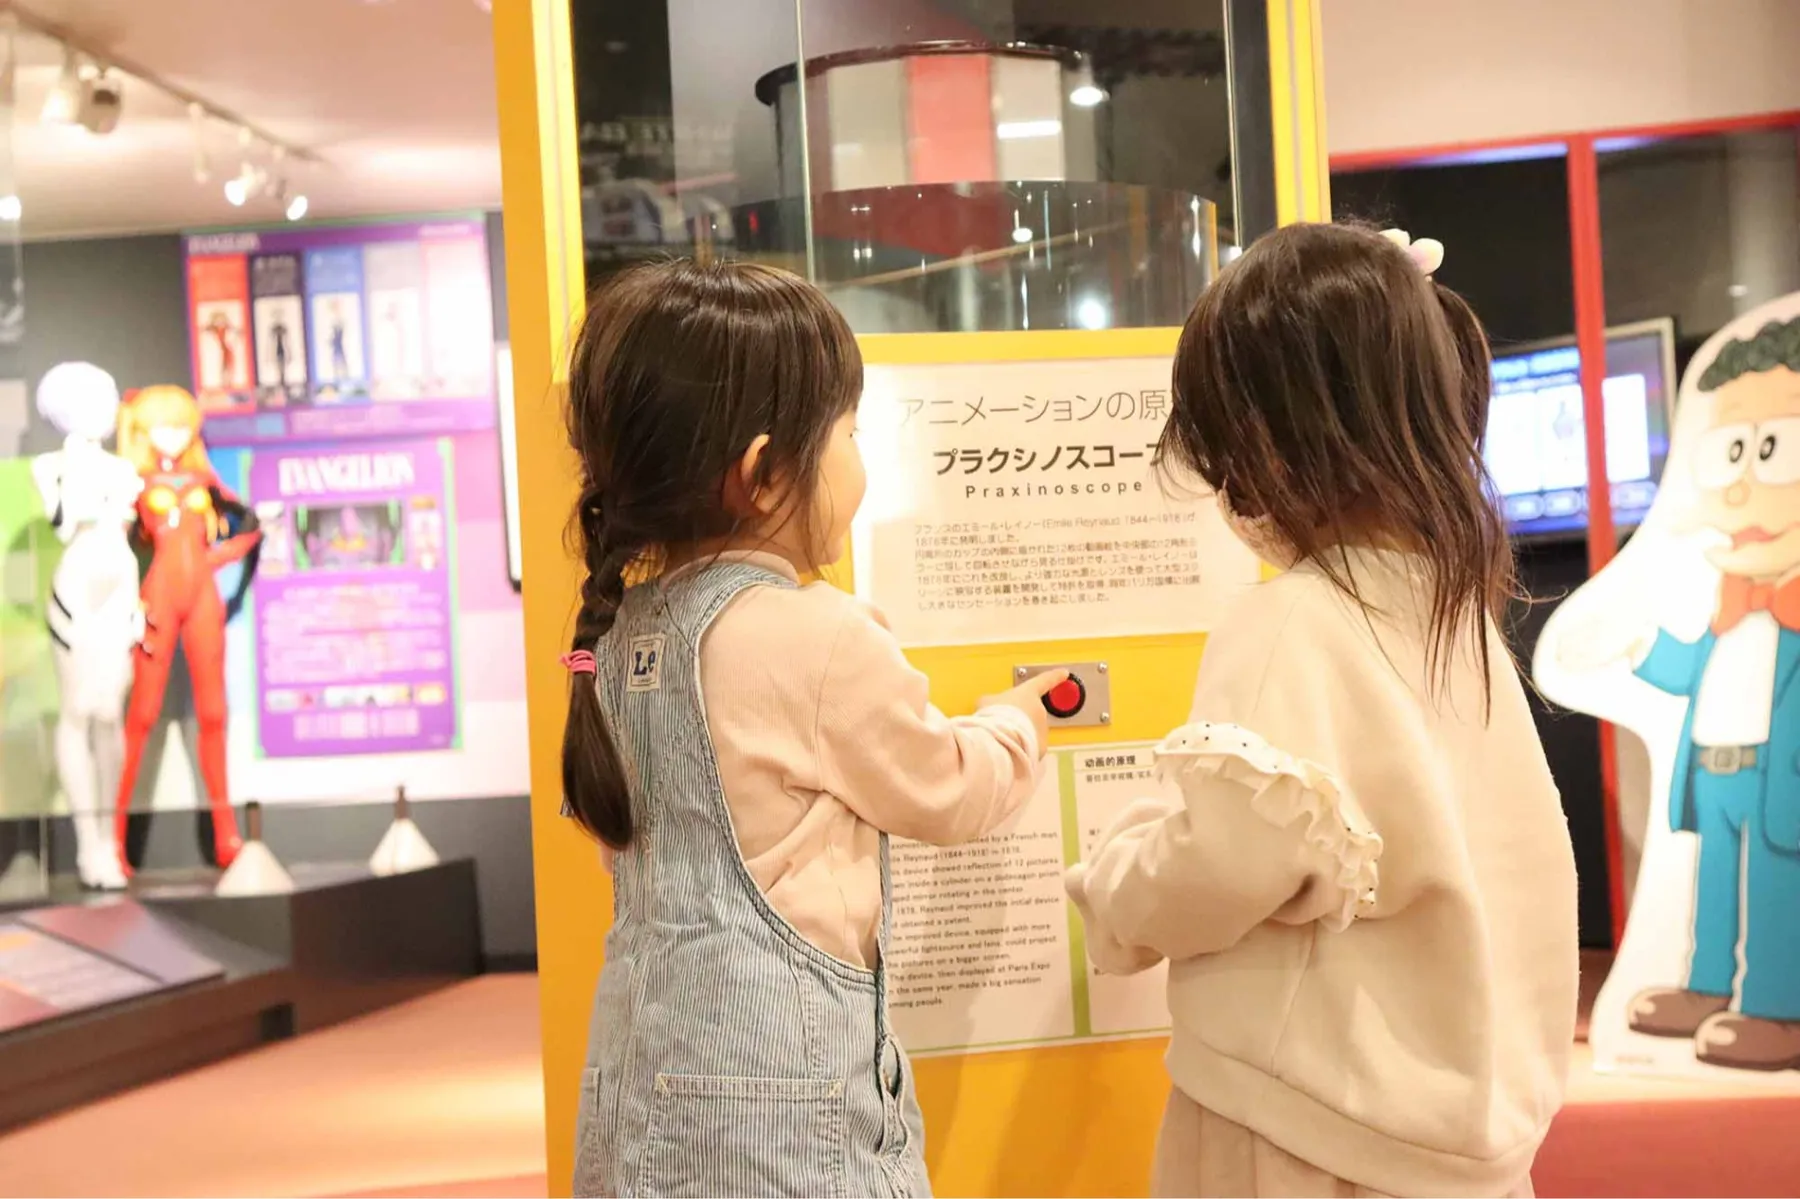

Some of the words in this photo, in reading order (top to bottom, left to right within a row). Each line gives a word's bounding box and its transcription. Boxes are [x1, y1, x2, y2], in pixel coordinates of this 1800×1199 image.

[898, 389, 1174, 426] アニメーションの原
[965, 480, 1143, 498] Praxinoscope
